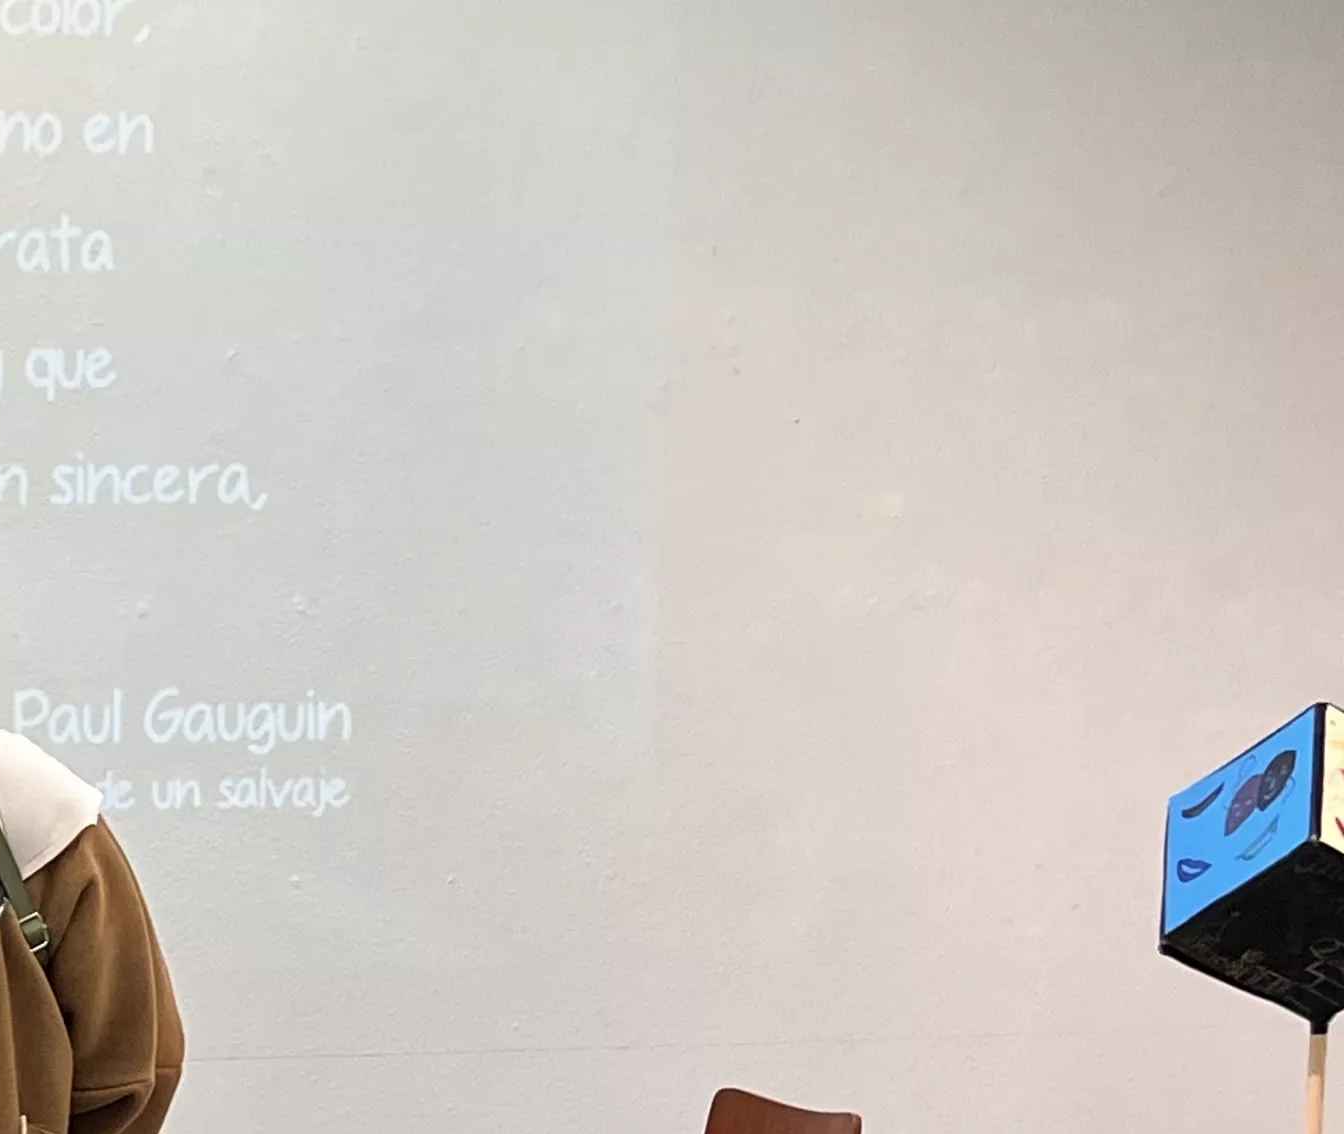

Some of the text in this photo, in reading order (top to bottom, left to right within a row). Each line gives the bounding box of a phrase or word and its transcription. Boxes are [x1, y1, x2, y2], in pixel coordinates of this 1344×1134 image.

[0, 0, 151, 44] color,
[83, 110, 155, 155] en
[24, 346, 118, 401] que
[50, 451, 269, 511] sincera,
[14, 686, 353, 756] Paul Gauguin
[151, 777, 203, 811] un
[216, 768, 351, 817] salvaje
